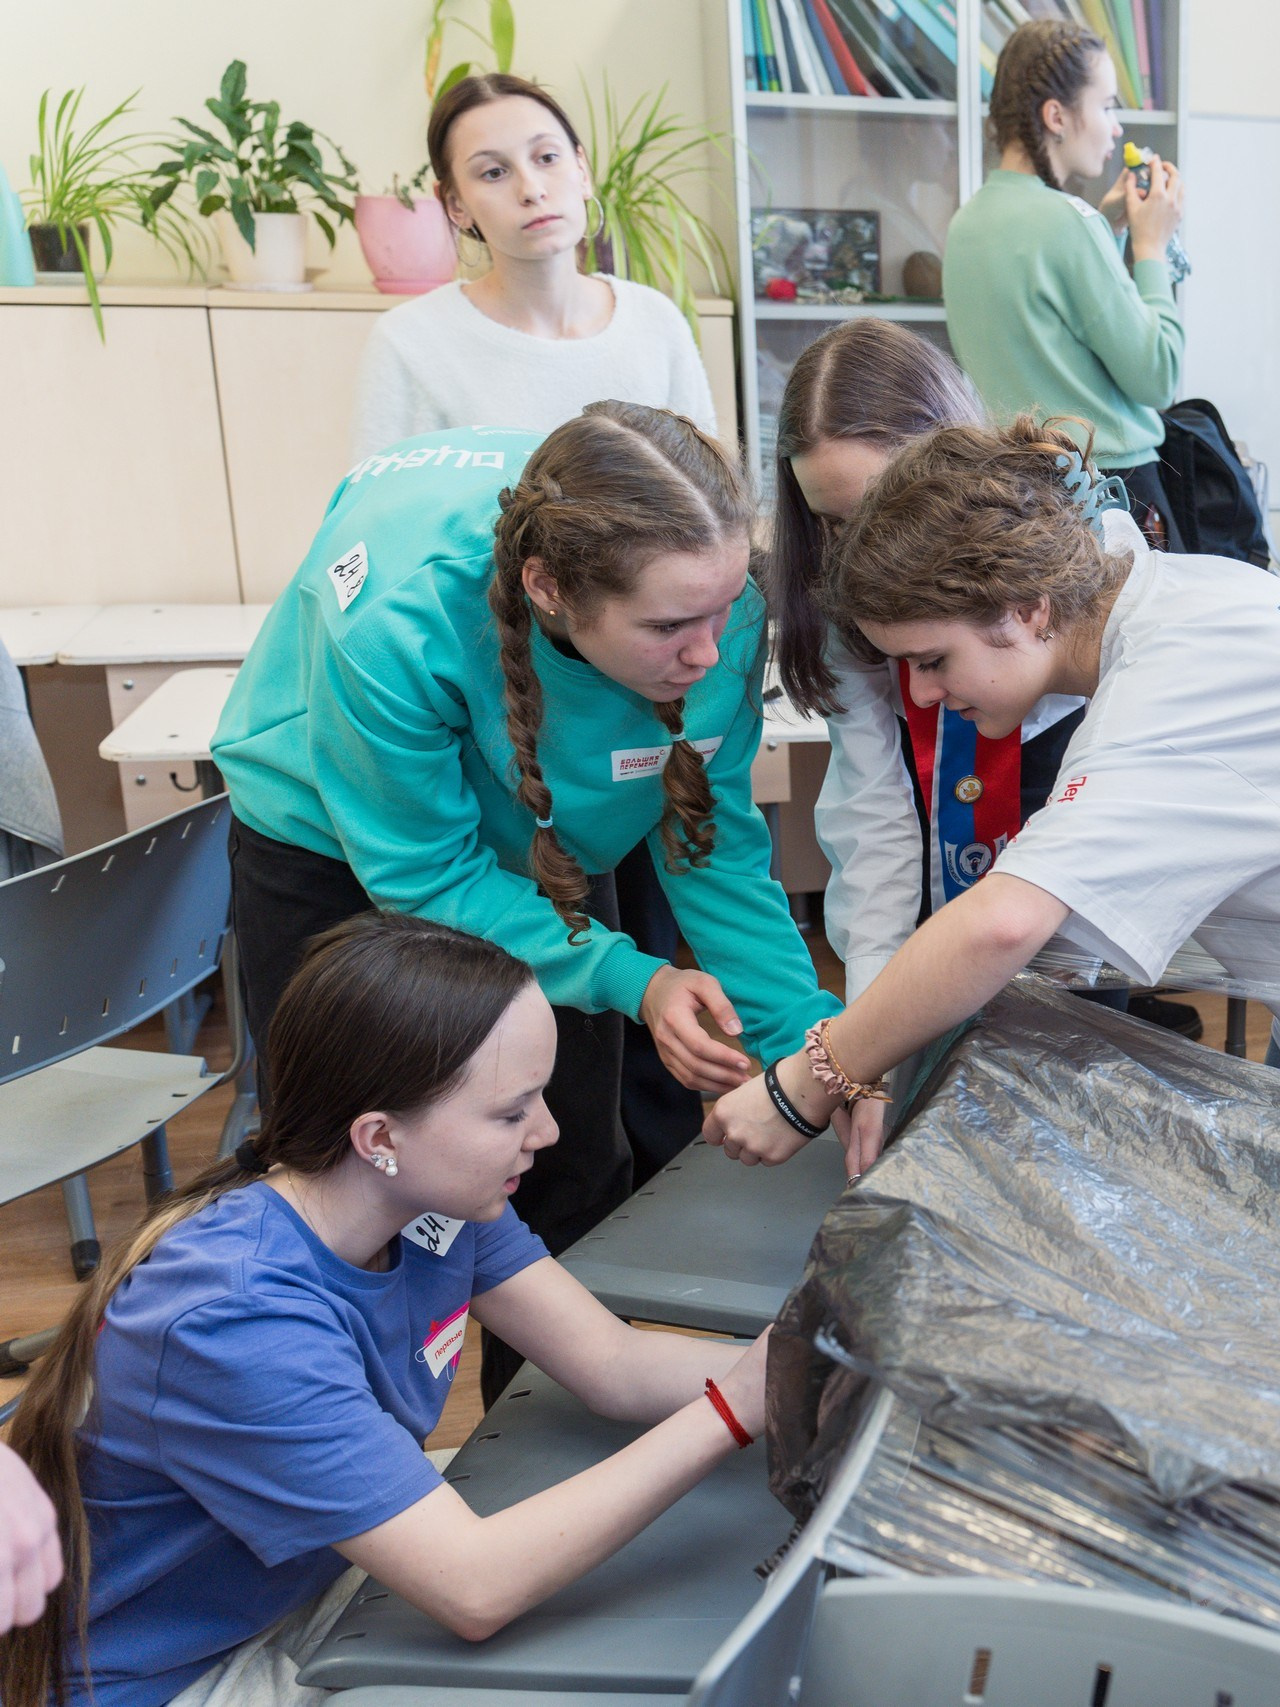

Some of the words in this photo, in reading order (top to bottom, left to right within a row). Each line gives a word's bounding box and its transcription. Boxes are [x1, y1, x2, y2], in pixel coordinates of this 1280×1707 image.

[619, 760, 659, 771] ПЕРЕМЕНА
[620, 755, 660, 766] БОЛЬШАЯ
[434, 1329, 463, 1360] Первые
